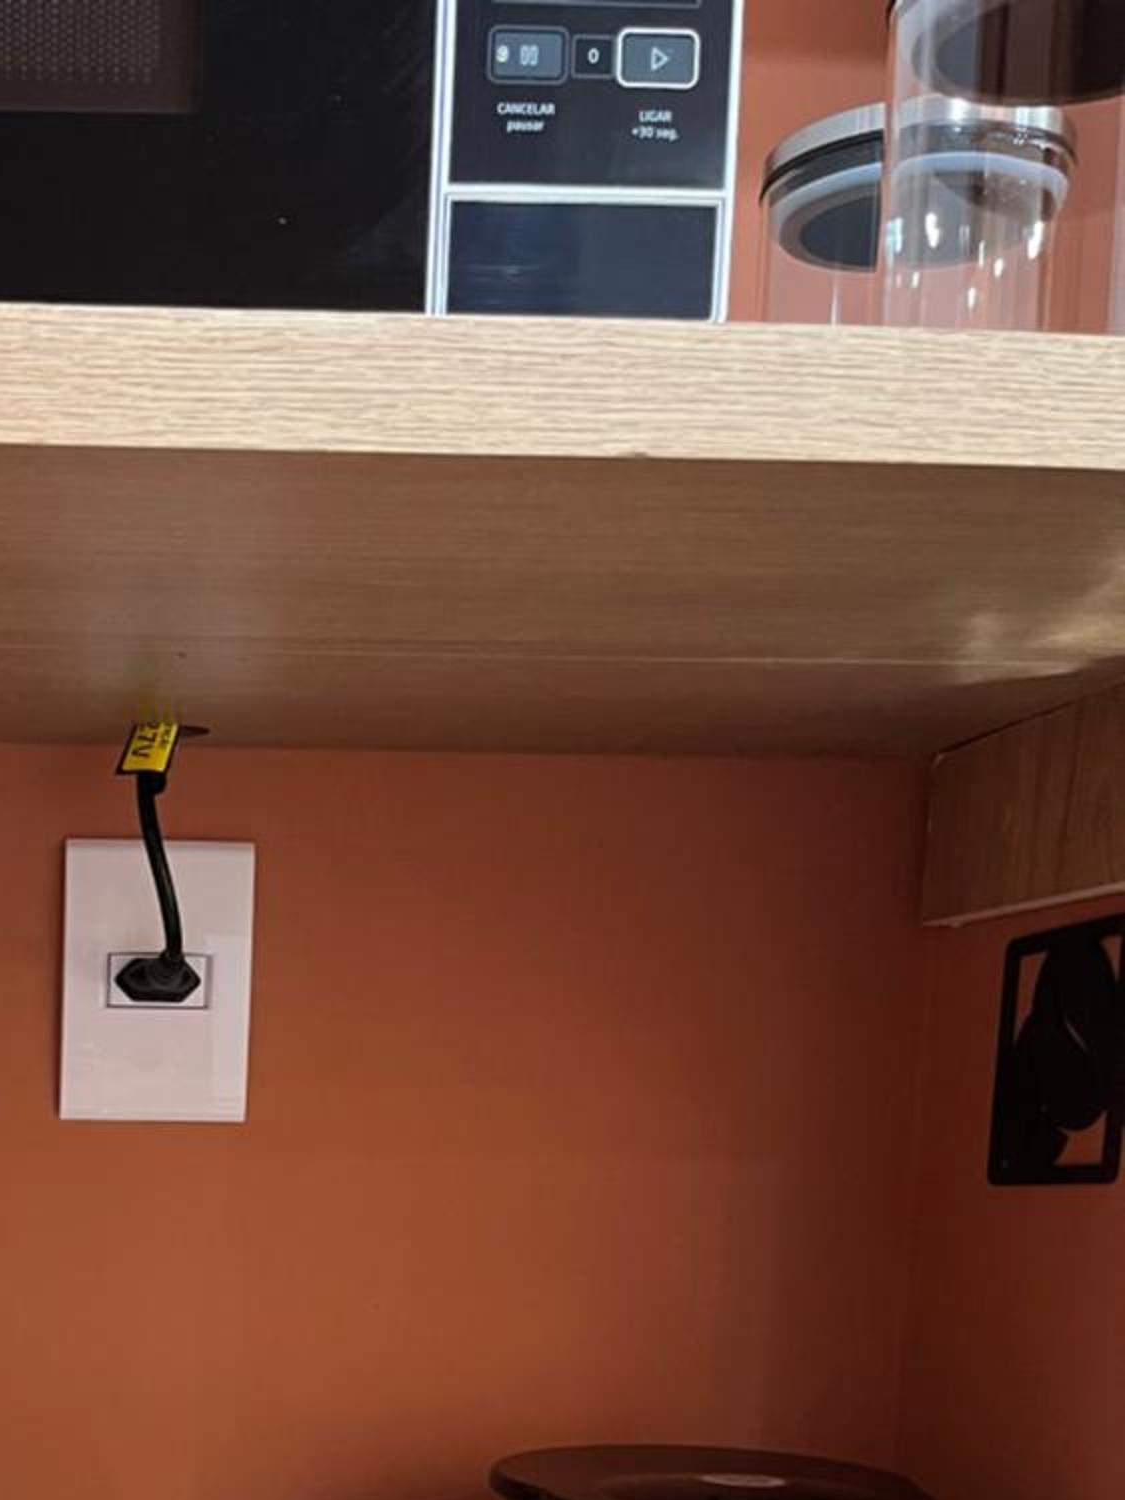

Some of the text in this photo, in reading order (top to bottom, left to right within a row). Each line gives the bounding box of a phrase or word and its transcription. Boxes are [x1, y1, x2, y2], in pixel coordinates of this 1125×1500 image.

[496, 101, 556, 117] CANCELAR
[638, 109, 673, 124] LIGAR
[505, 119, 545, 134] pausar
